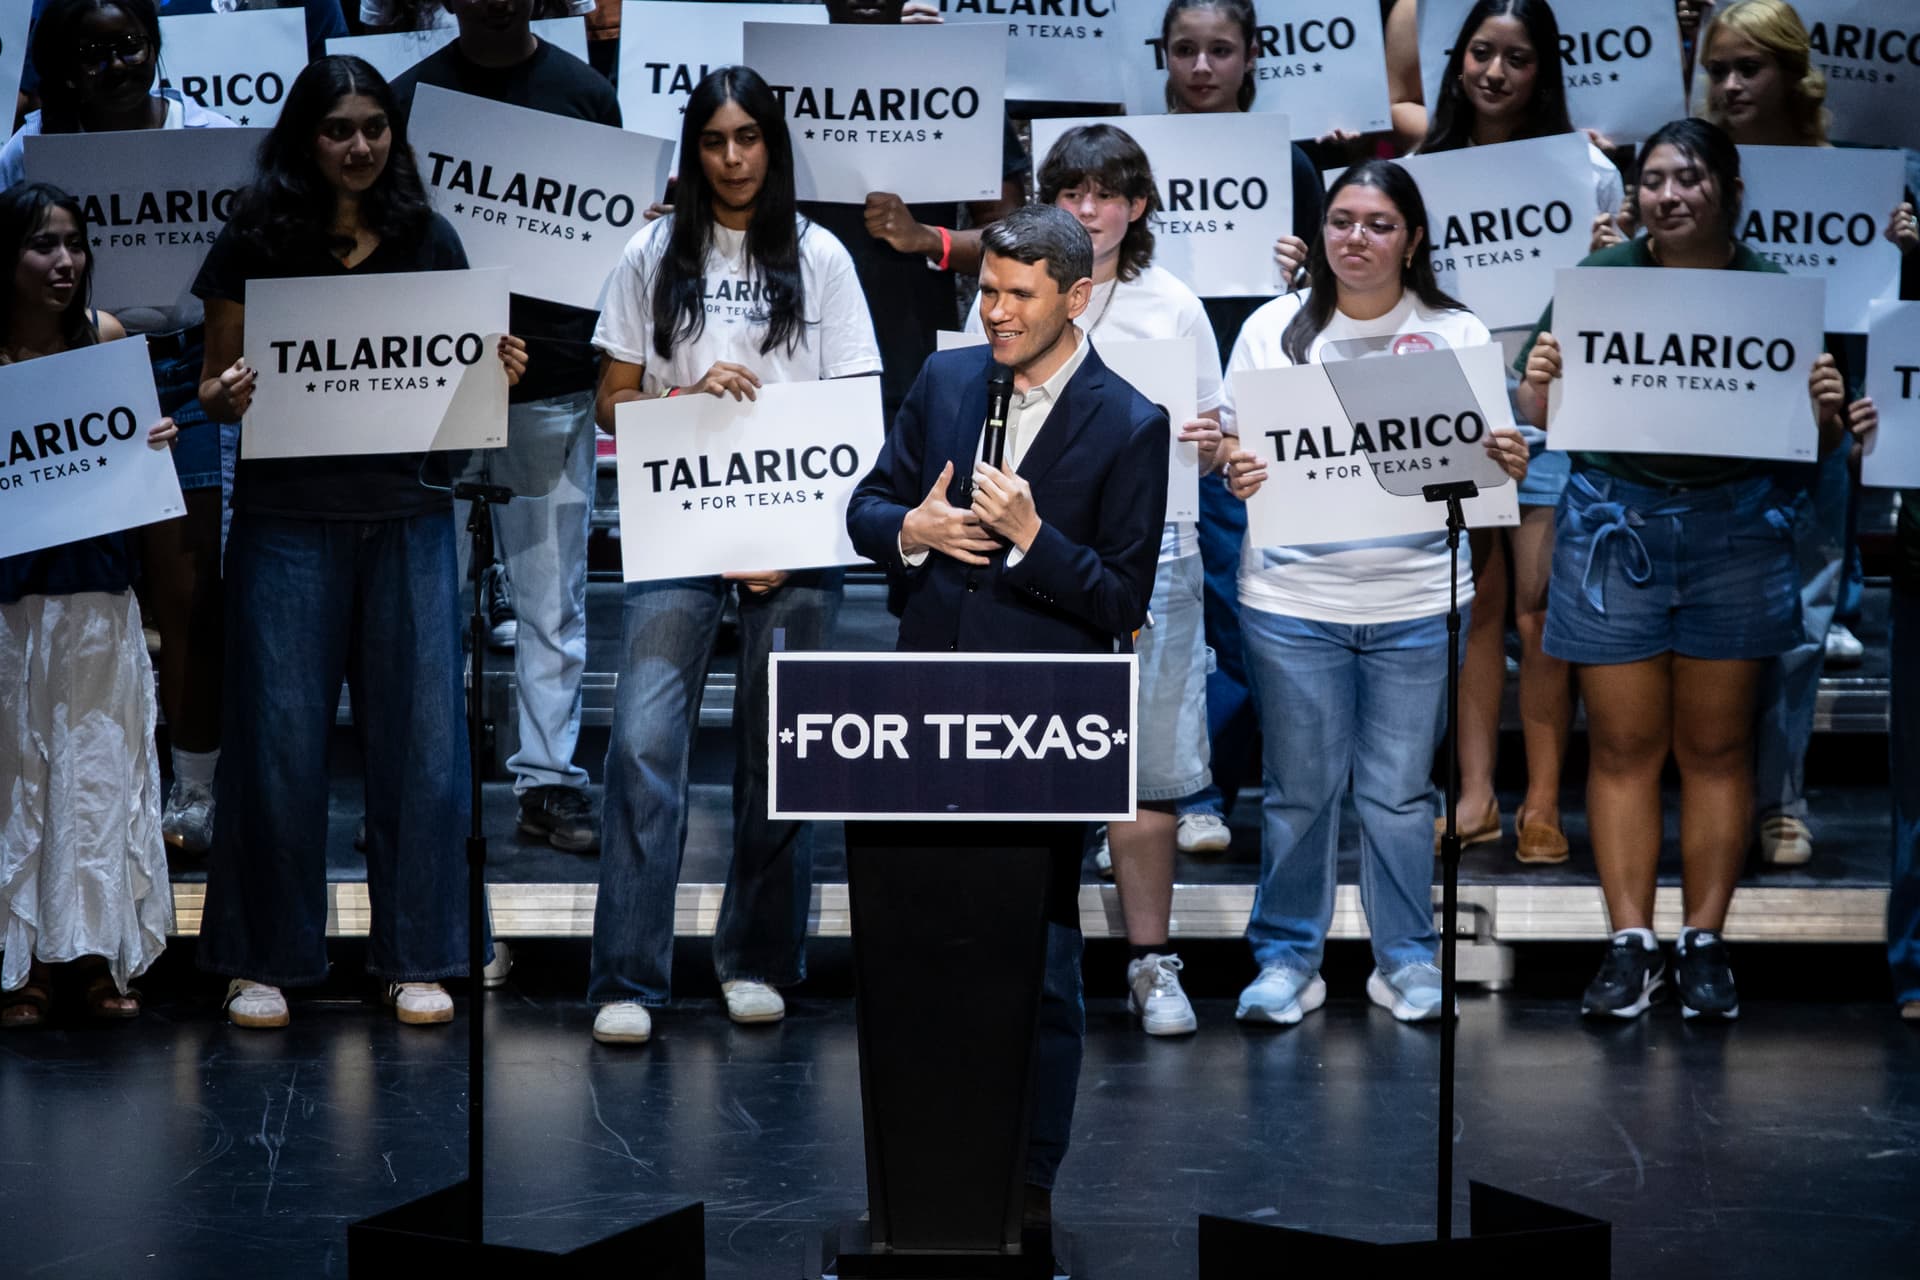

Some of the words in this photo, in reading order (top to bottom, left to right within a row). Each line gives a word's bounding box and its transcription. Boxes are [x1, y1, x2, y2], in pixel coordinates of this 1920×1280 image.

[1027, 24, 1087, 39] TEXAS
[159, 71, 284, 108] RICO
[768, 85, 979, 120] TALARICO
[823, 128, 858, 142] FOR
[867, 129, 927, 143] TEXAS
[428, 151, 635, 228] TALARICO
[111, 234, 147, 248] FOR
[155, 231, 217, 245] TEXAS
[471, 206, 508, 225] FOR
[516, 215, 575, 240] TEXAS
[1158, 219, 1217, 234] TEXAS
[1430, 200, 1573, 250] ARICO
[1464, 248, 1525, 268] TEXAS
[270, 332, 484, 373] TALARICO
[1578, 330, 1796, 372] TALARICO
[324, 379, 360, 392] FOR
[368, 376, 430, 390] TEXAS
[1631, 374, 1668, 388] FOR
[1677, 375, 1739, 391] TEXAS
[0, 406, 137, 469] ARICO
[1264, 410, 1485, 462] TALARICO
[30, 459, 91, 483] TEXAS
[643, 443, 860, 493] TALARICO
[1326, 465, 1362, 480] FOR
[1371, 456, 1433, 475] TEXAS
[700, 495, 737, 510] FOR
[745, 490, 807, 507] TEXAS
[797, 713, 910, 759] FOR
[923, 713, 1112, 760] TEXAS
